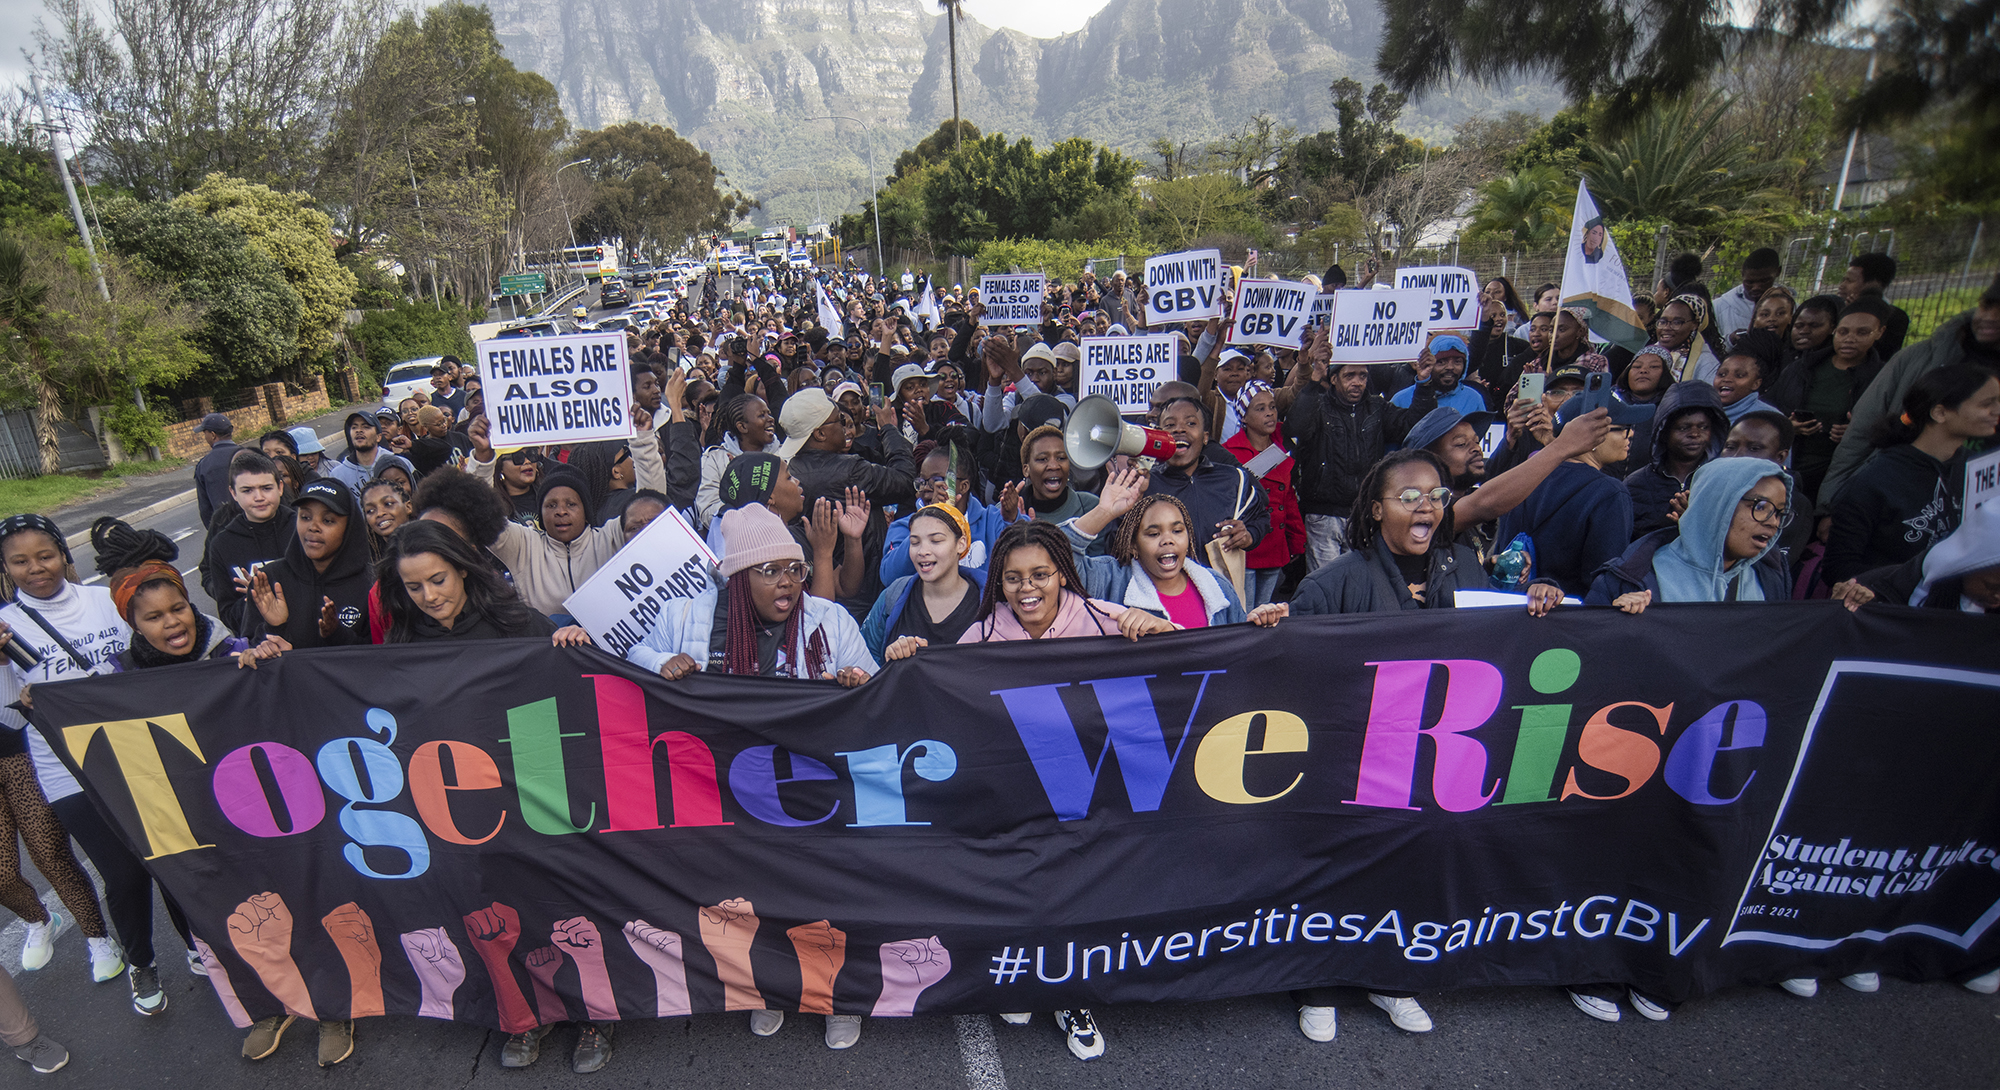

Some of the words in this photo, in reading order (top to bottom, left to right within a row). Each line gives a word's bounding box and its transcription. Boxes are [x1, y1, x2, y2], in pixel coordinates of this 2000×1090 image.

[1150, 262, 1185, 287] DOWN
[1187, 258, 1216, 281] WITH
[1401, 274, 1437, 294] DOWN
[1441, 273, 1470, 294] WITH
[984, 280, 1021, 294] FEMALES
[1022, 279, 1040, 293] ARE
[1152, 284, 1216, 314] GBV
[984, 305, 1010, 320] HUMAN
[1011, 304, 1039, 319] BEINGS
[988, 295, 1030, 304] ALSO
[1243, 288, 1275, 309] DOWN
[1275, 289, 1306, 312] WITH
[1373, 301, 1397, 320] NO
[1429, 298, 1468, 321] BV
[1240, 313, 1299, 338] GBV
[1336, 324, 1361, 347] BAIL
[1362, 323, 1383, 346] FOR
[1384, 321, 1422, 345] RAPIST
[488, 346, 574, 380] FEMALES
[581, 344, 618, 372] ARE
[1088, 343, 1144, 366] FEMALES
[1145, 342, 1170, 364] ARE
[1093, 367, 1156, 383] ALSO
[504, 378, 598, 401] ALSO
[1131, 381, 1165, 405] BEIN
[497, 402, 558, 434] HUMAN
[562, 396, 622, 430] BEINGS
[1975, 464, 1996, 494] THE
[614, 562, 654, 602] NO
[602, 619, 644, 659] BAIL
[629, 595, 661, 635] FOR
[655, 553, 707, 602] RAPIST
[38, 644, 58, 656] WE
[63, 633, 94, 652] OULD
[42, 640, 125, 680] FEMNISTS
[62, 673, 958, 879] Together
[990, 670, 1309, 822] We
[1340, 648, 1768, 813] Rise
[1764, 834, 1918, 872] Students
[1753, 862, 1884, 898] Against
[1884, 868, 1948, 895] GBV
[1740, 904, 1766, 917] SINCE
[1770, 906, 1799, 919] 2021
[989, 895, 1710, 985] #UniversitiesAgainstGBV
